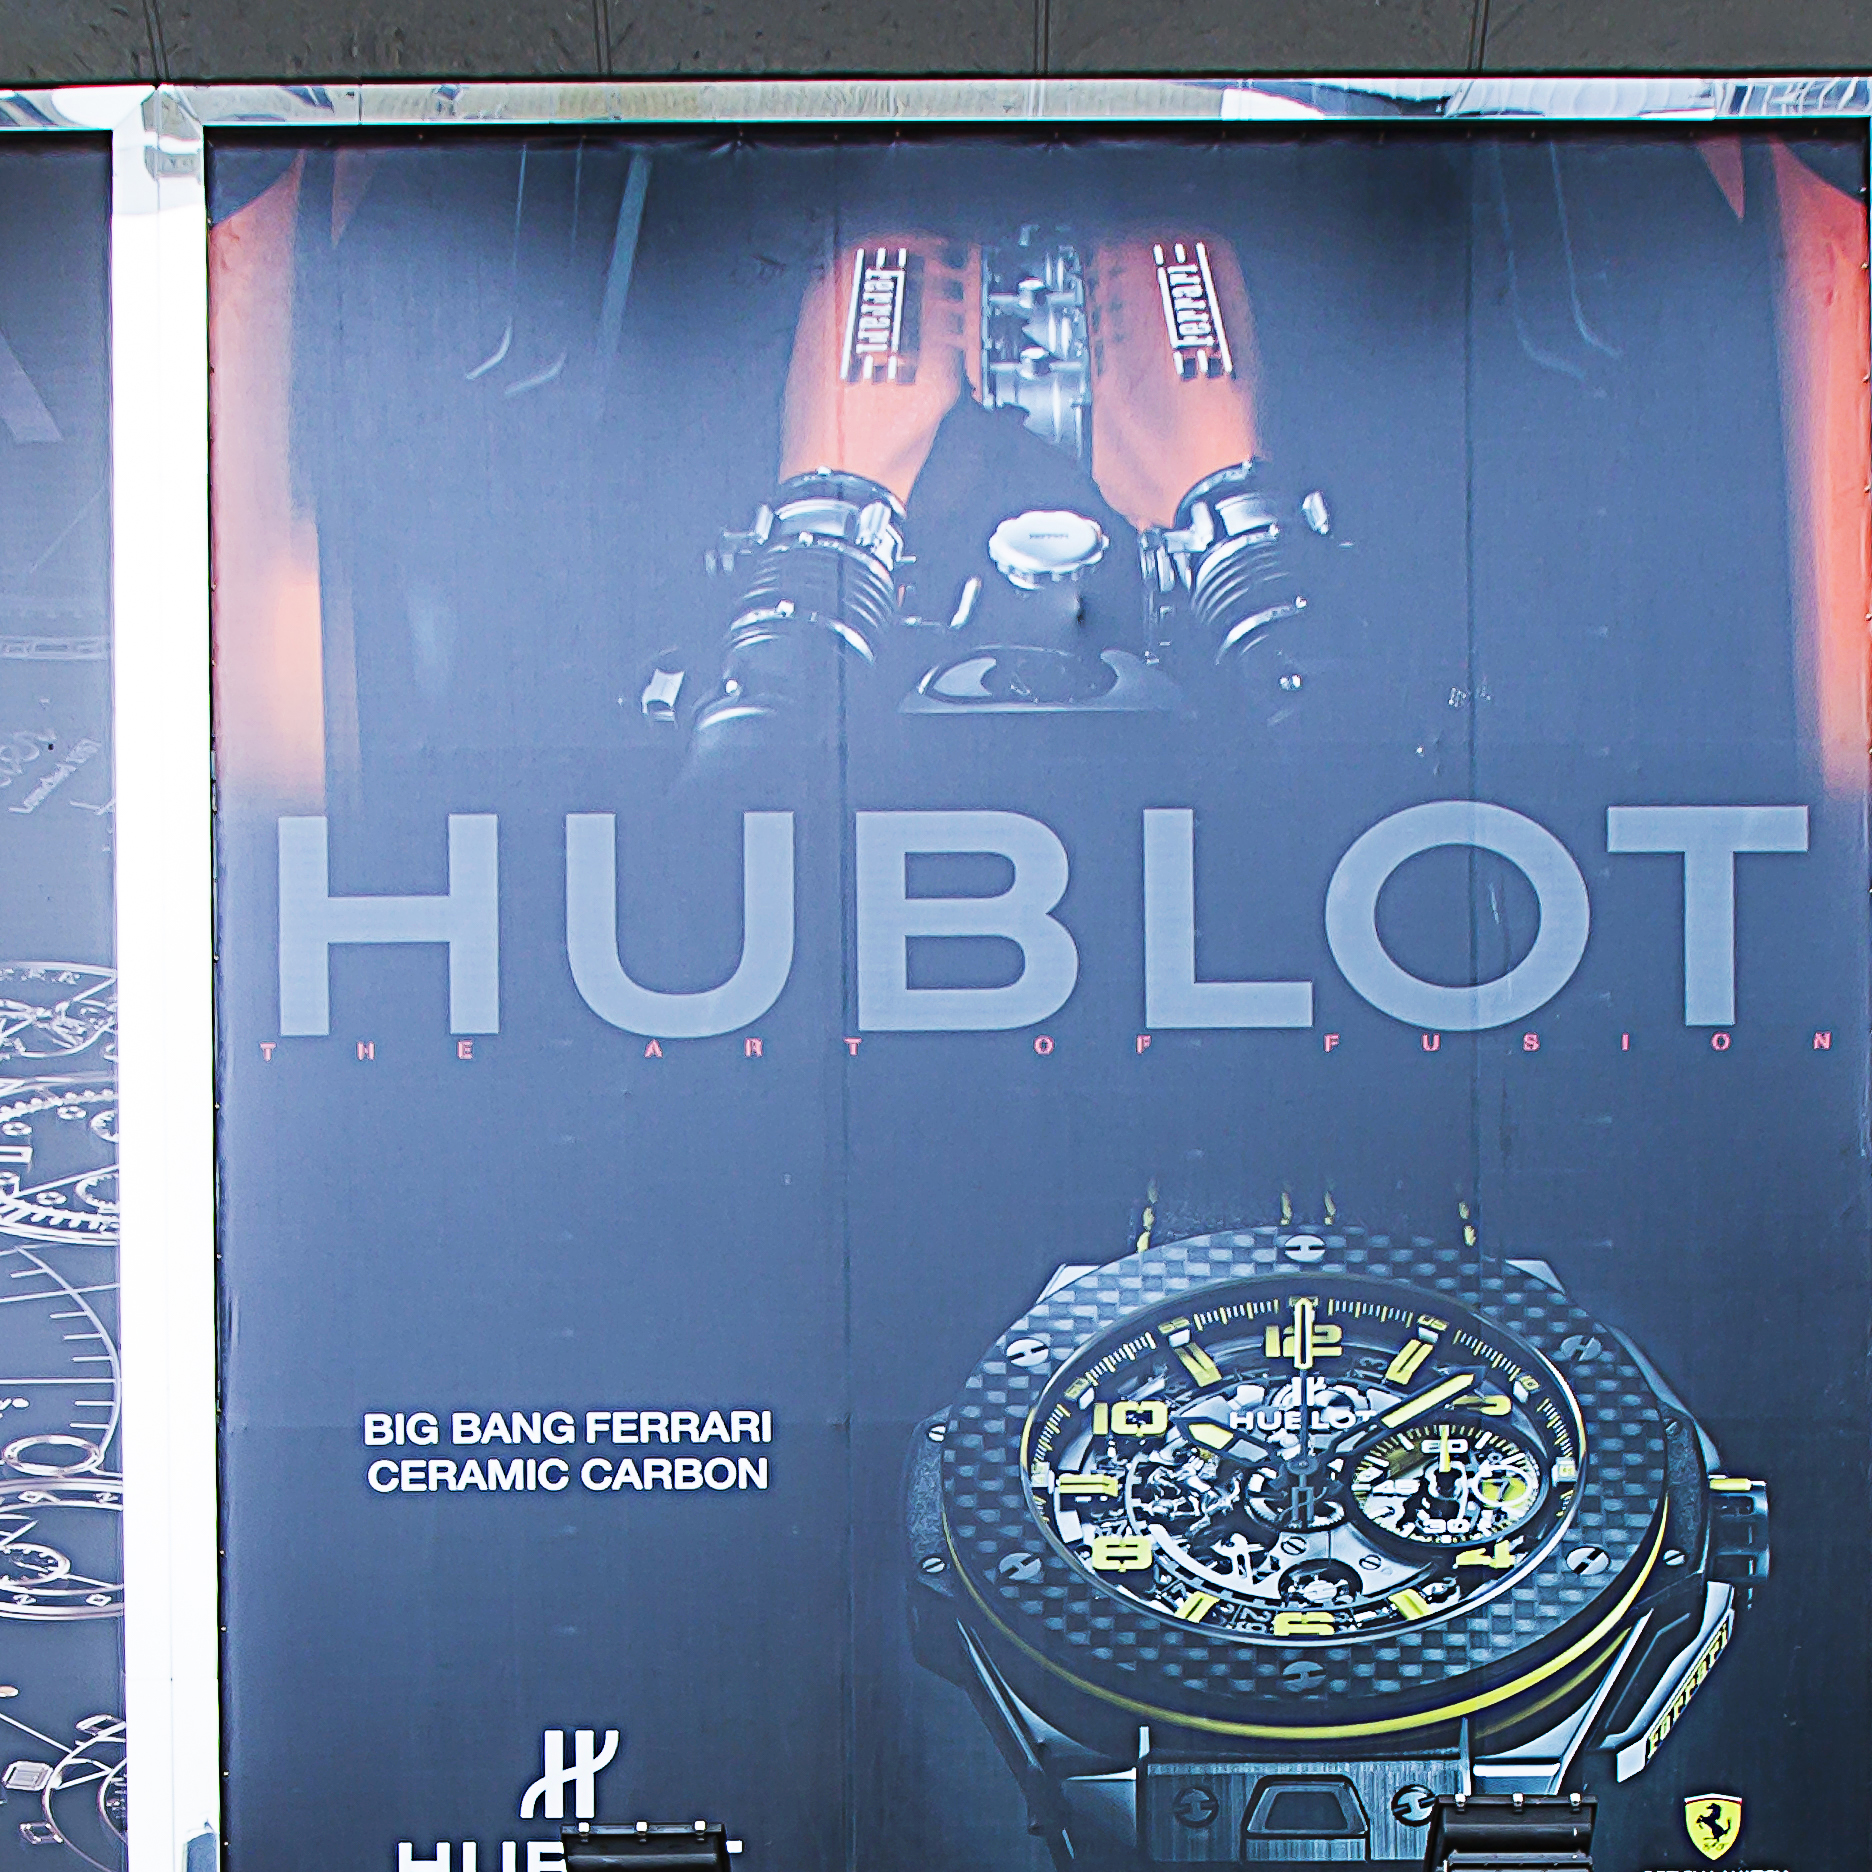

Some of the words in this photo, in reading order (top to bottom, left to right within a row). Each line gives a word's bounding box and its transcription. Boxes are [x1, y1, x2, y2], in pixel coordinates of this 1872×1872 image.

[278, 799, 1810, 1039] HUBLOT
[1323, 1030, 1832, 1054] FUSION
[363, 1411, 440, 1447] BIG
[451, 1411, 576, 1446] BANG
[585, 1410, 773, 1445] FERRARI
[366, 1457, 571, 1494] CERAMIC
[580, 1455, 770, 1492] CARBON
